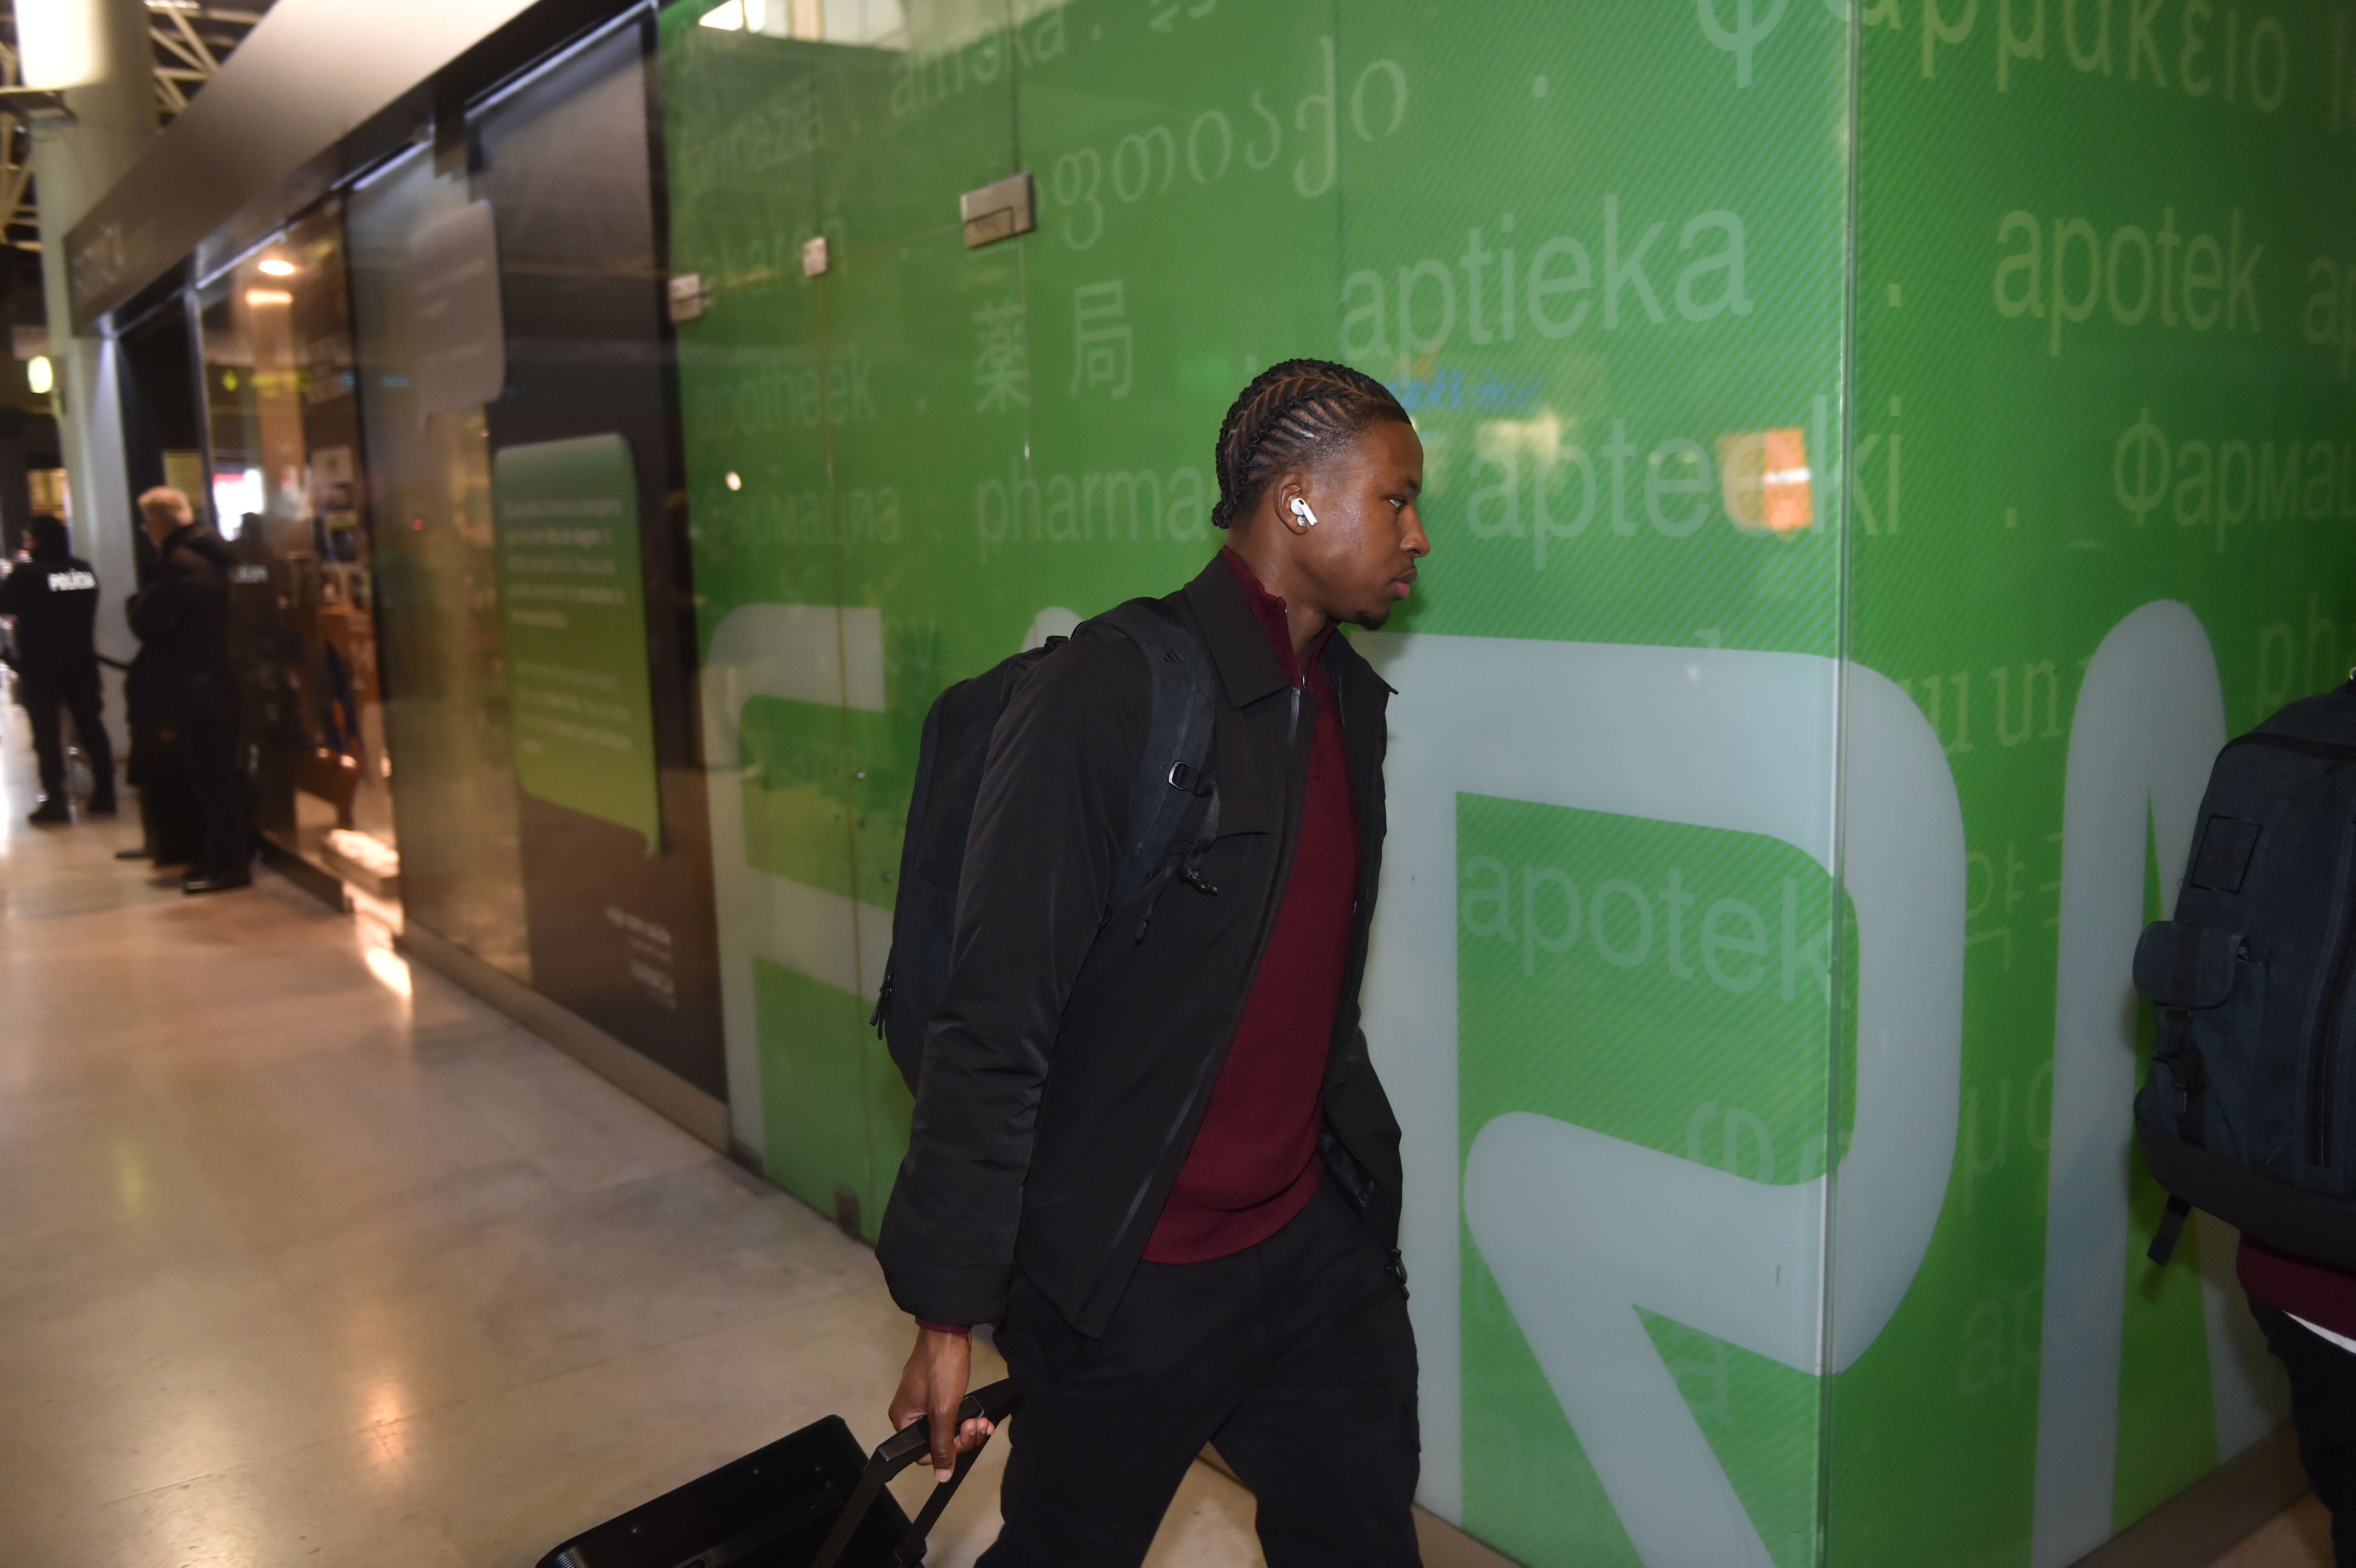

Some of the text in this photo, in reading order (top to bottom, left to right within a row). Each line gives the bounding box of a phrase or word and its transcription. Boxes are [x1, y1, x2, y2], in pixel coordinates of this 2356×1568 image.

[1340, 194, 1754, 387] aptieka
[1992, 206, 2266, 359] apotek
[976, 454, 1220, 566] pharma
[1461, 854, 1834, 1003] apotek
